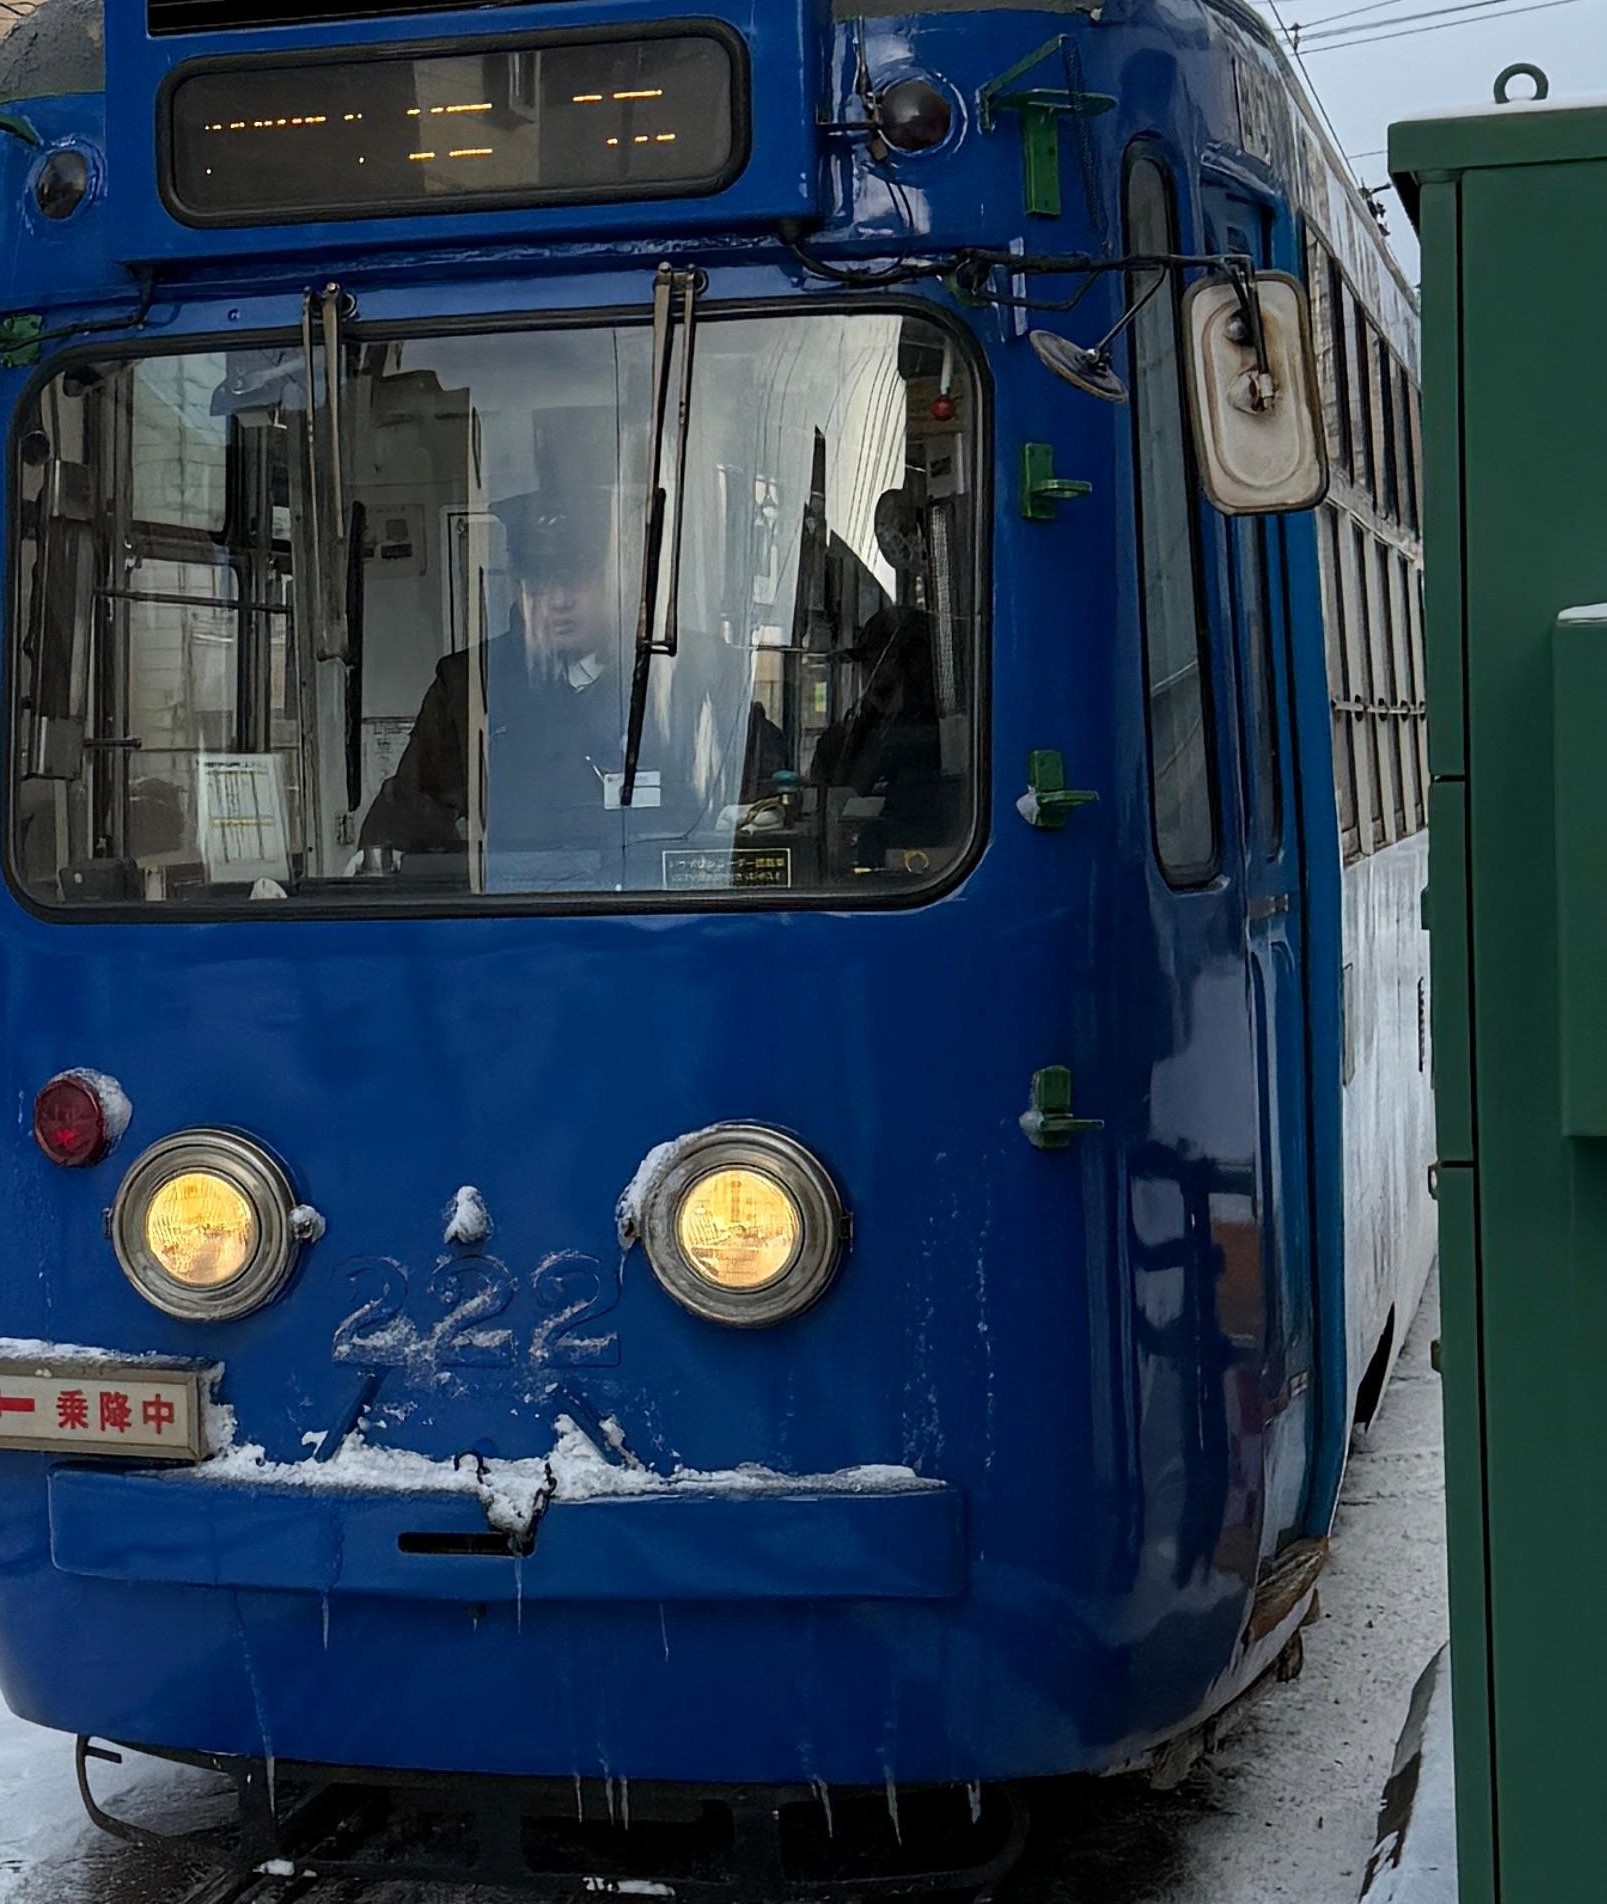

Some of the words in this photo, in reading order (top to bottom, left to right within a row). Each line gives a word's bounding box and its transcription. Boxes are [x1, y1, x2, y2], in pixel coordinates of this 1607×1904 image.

[331, 1251, 622, 1369] 222
[56, 1389, 175, 1434] 乗降中
